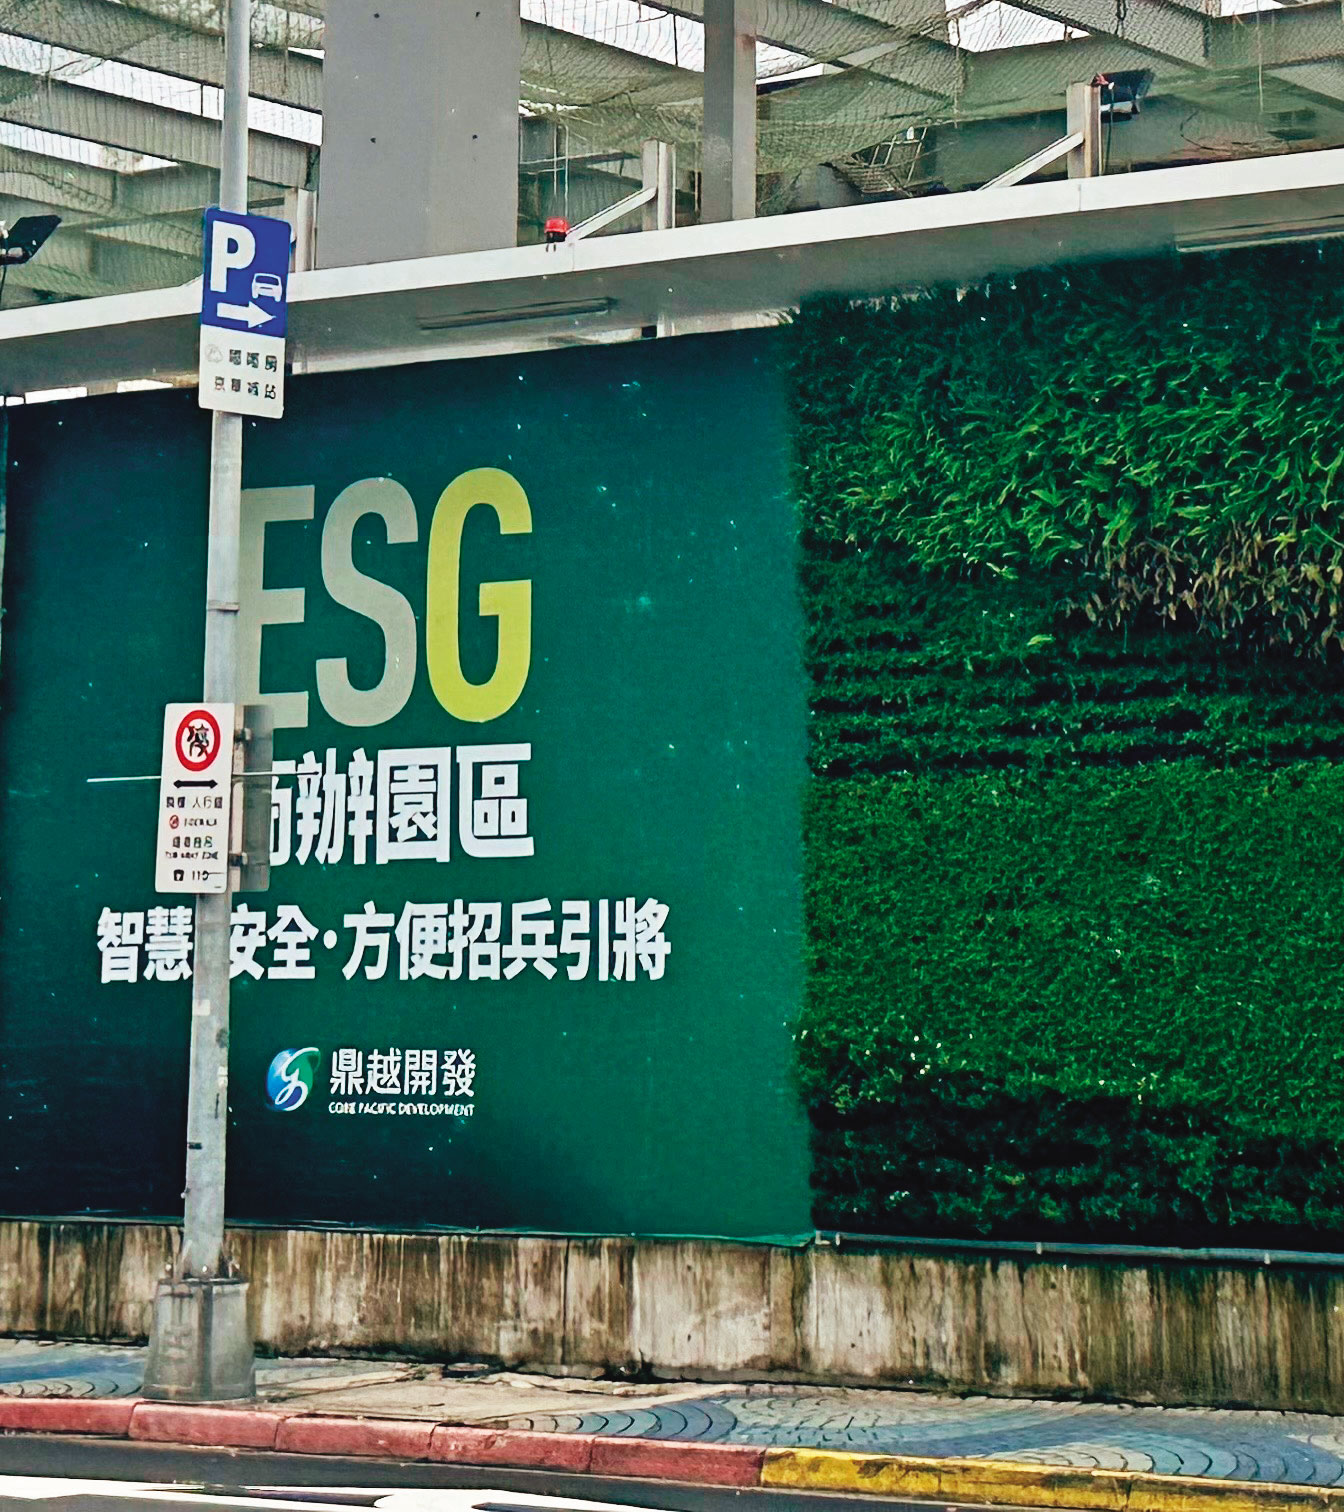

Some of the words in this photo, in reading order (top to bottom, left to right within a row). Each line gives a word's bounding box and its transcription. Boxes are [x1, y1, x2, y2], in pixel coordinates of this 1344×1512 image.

[210, 220, 256, 293] P
[236, 467, 533, 728] ESG
[96, 897, 672, 984] 智慧安全·方便招兵引將
[329, 1047, 477, 1097] 鼎越開發
[398, 1102, 475, 1117] DEVELOPMENT
